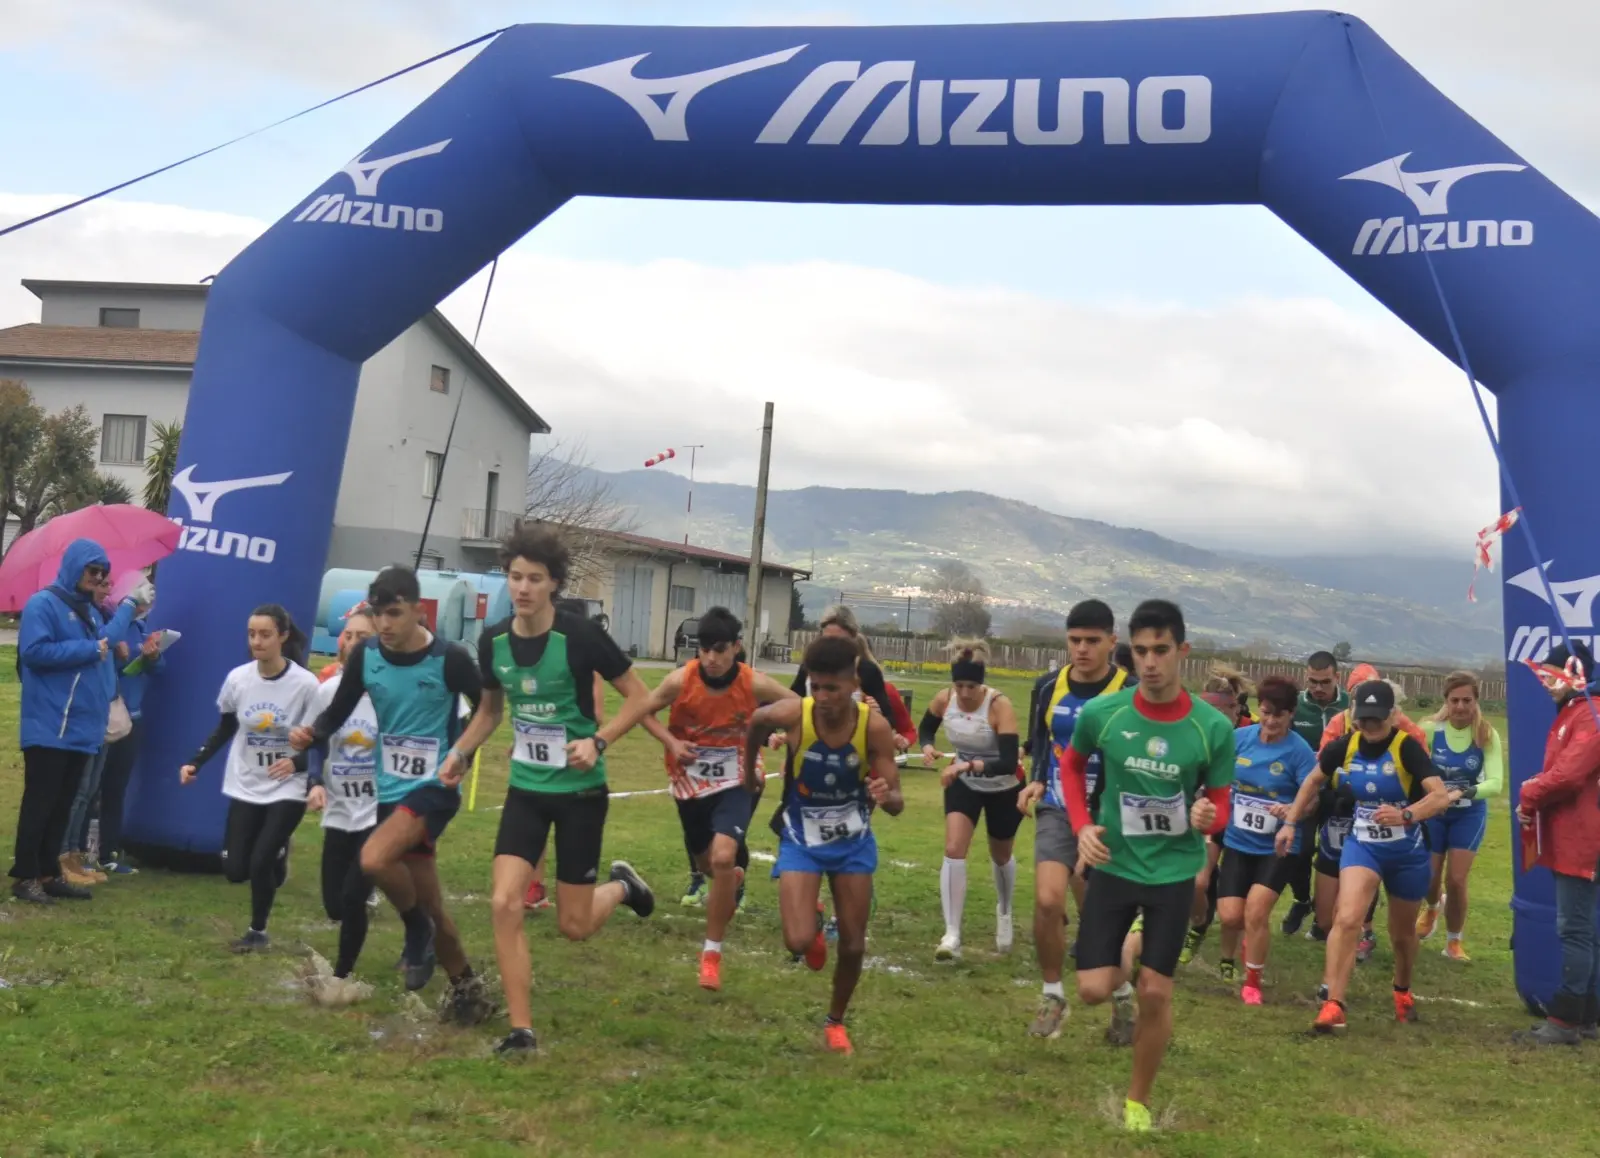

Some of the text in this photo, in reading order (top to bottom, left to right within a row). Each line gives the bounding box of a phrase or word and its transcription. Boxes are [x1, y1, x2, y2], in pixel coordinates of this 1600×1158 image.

[167, 517, 277, 564] IZUNO
[526, 742, 549, 762] 16
[391, 752, 426, 776] 128
[698, 761, 725, 777] 25
[1123, 756, 1180, 775] AIELLO
[342, 780, 375, 798] 114
[1242, 812, 1265, 830] 49
